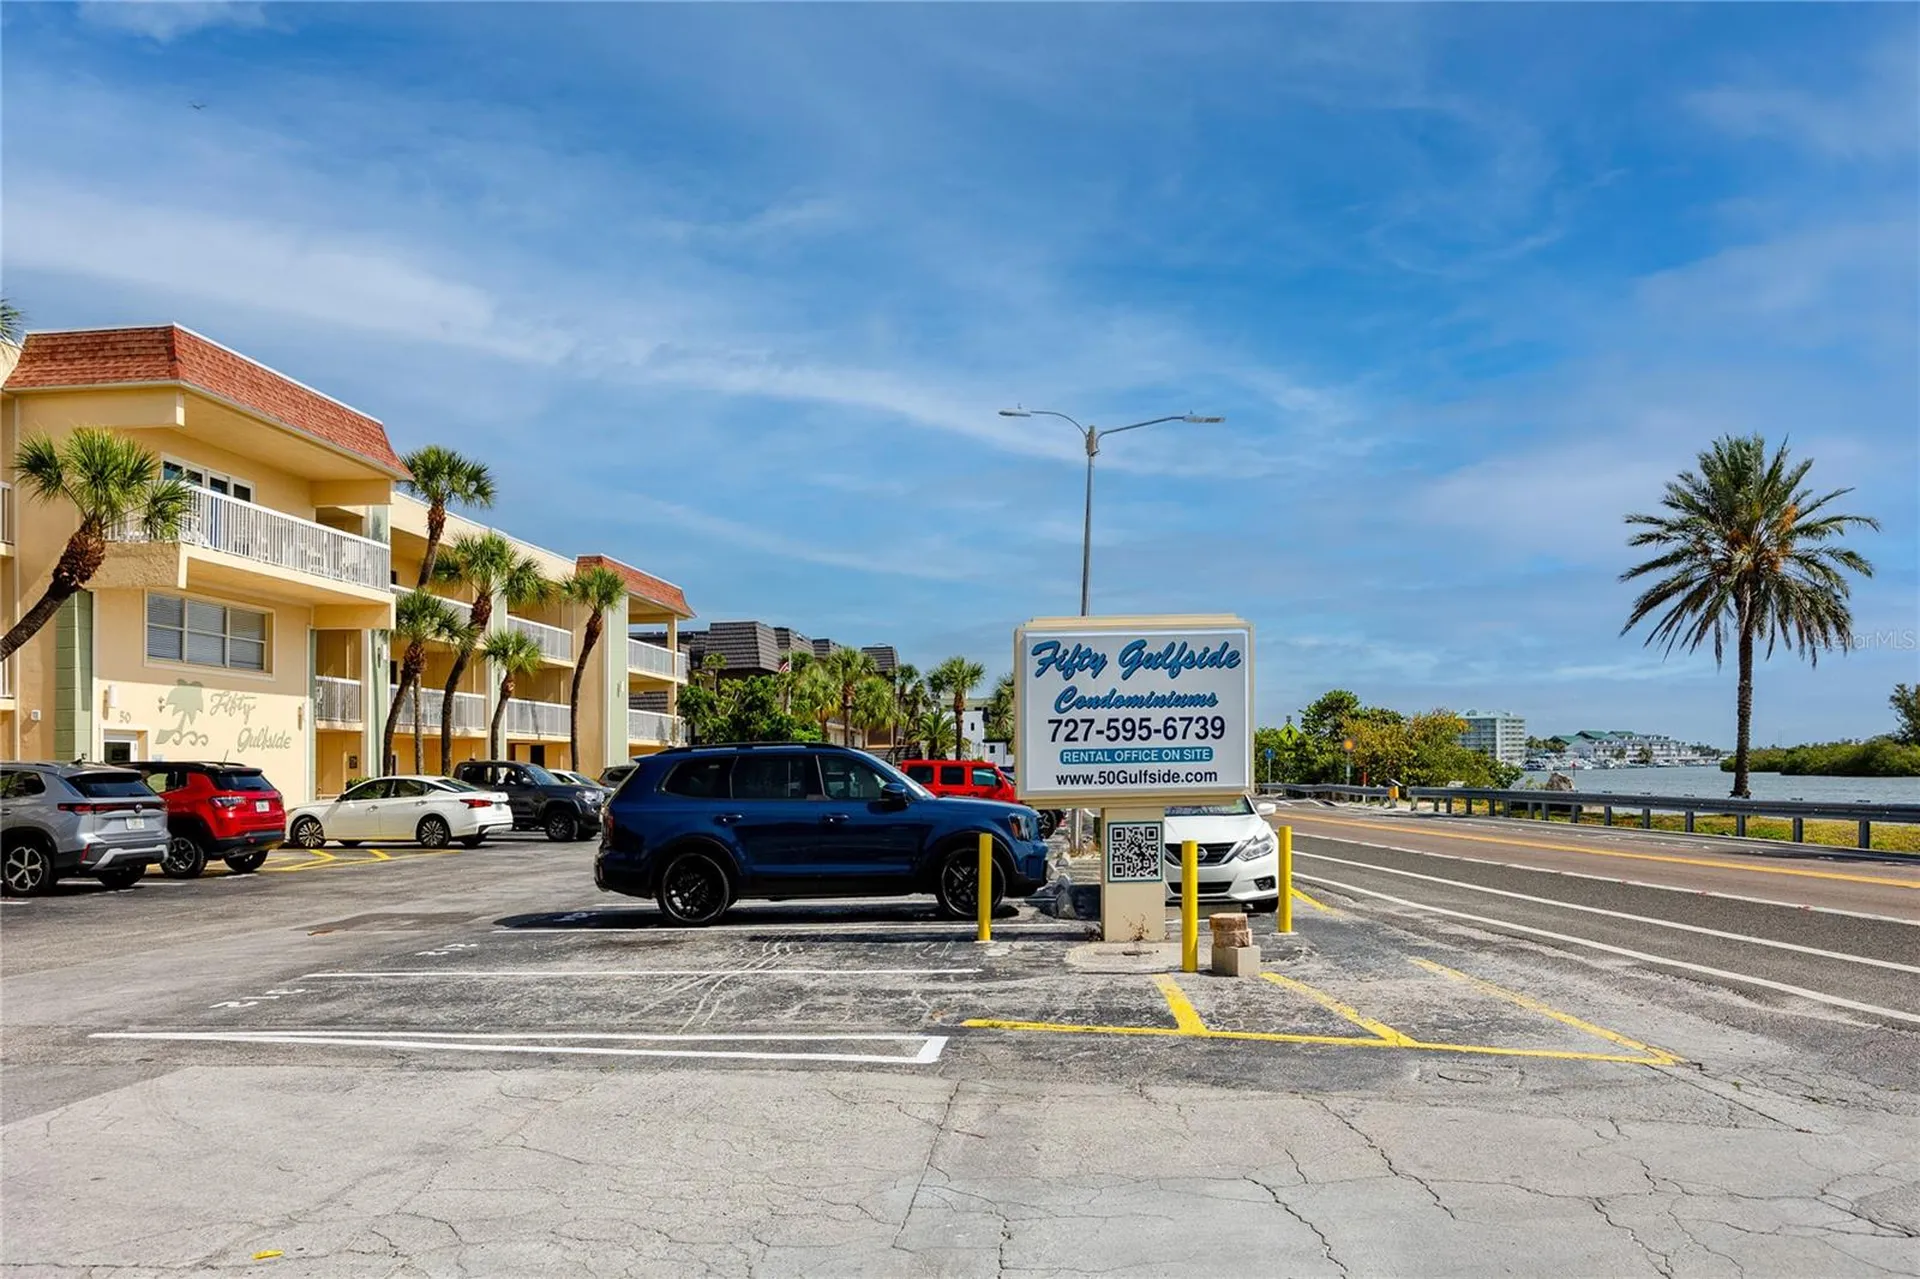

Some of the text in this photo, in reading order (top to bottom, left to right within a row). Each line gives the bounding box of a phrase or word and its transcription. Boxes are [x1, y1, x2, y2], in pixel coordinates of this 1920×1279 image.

[1031, 639, 1241, 681] Fifty Gulfside
[210, 690, 257, 725] Fifty
[1054, 685, 1219, 714] Condominiums
[119, 710, 131, 724] 50
[1048, 715, 1225, 742] 727-595-6739
[237, 725, 292, 753] Gulfside
[1062, 747, 1210, 763] RENTAL OFFICE ON SITE
[1056, 769, 1218, 786] www.50Gulfside.com
